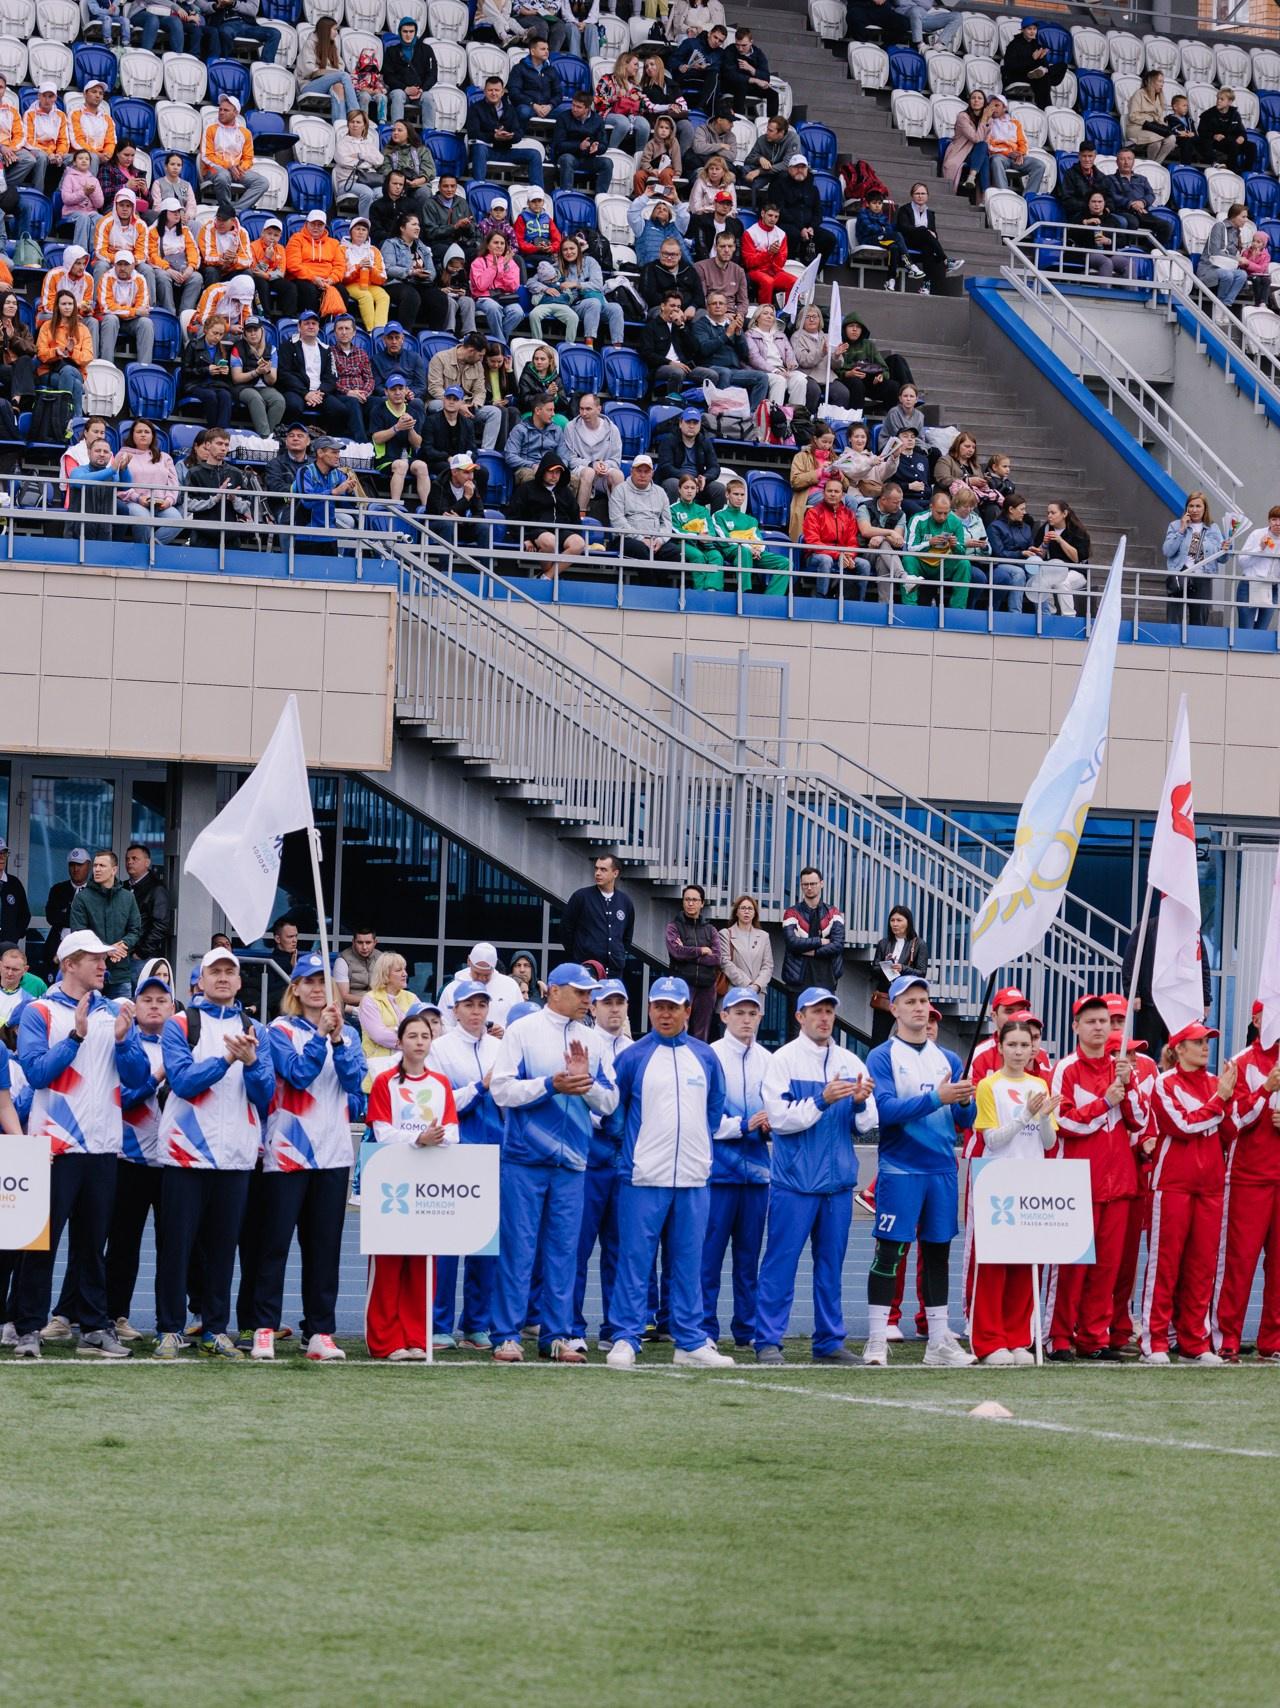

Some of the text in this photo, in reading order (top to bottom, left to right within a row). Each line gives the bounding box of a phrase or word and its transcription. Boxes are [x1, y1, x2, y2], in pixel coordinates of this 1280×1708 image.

[400, 1122, 428, 1131] КОМО
[1024, 1124, 1040, 1132] МОС
[415, 1183, 481, 1199] КОМОС
[415, 1201, 456, 1209] МИЛКОМ
[1019, 1196, 1076, 1211] КОМОС
[878, 1213, 897, 1233] 27
